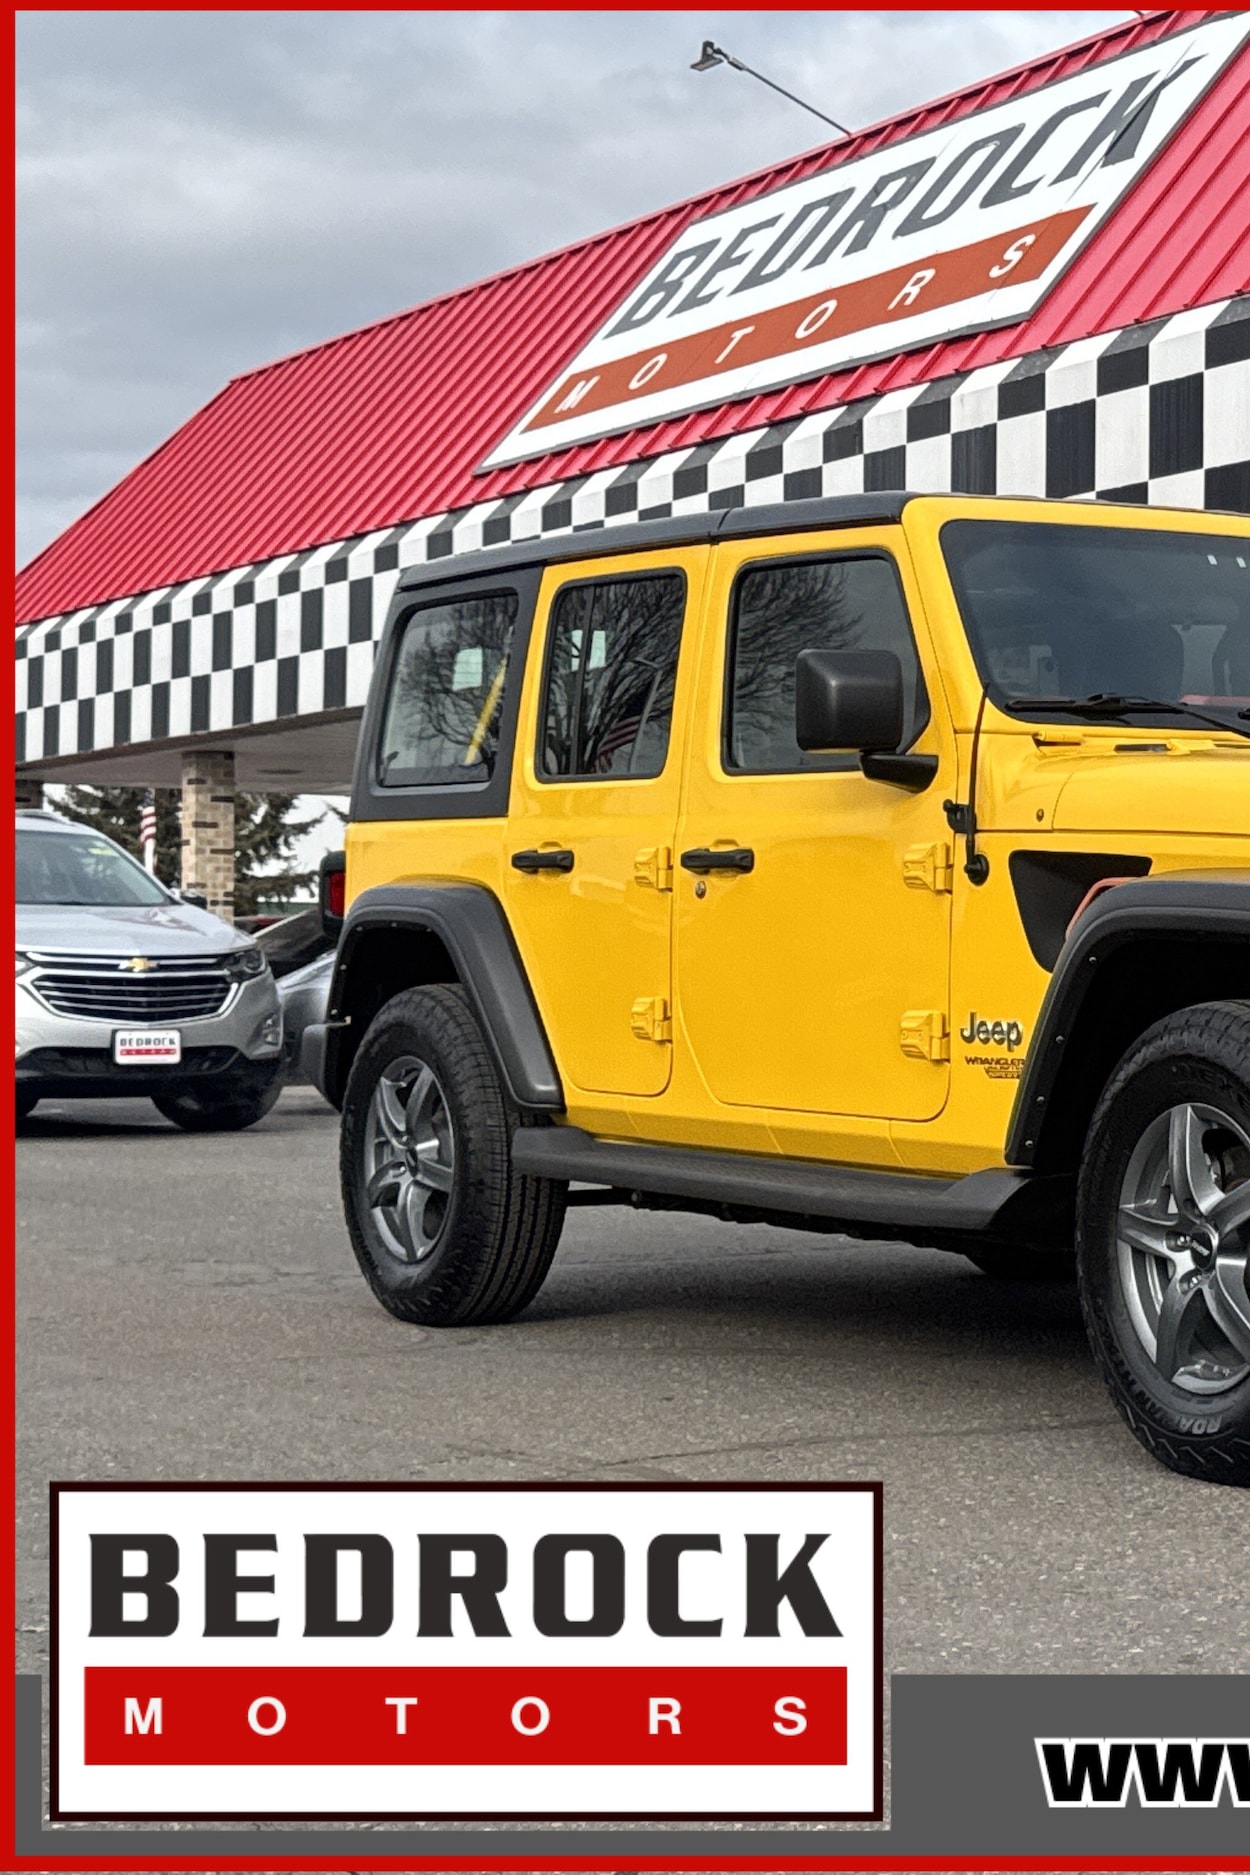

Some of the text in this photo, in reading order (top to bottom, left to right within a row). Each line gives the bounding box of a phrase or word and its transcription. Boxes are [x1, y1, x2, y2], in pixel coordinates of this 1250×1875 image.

[602, 53, 1206, 339] BEDROCK
[554, 234, 1036, 414] MOTORS
[960, 1011, 1023, 1052] Jeep
[964, 1055, 1025, 1066] WRANGLER
